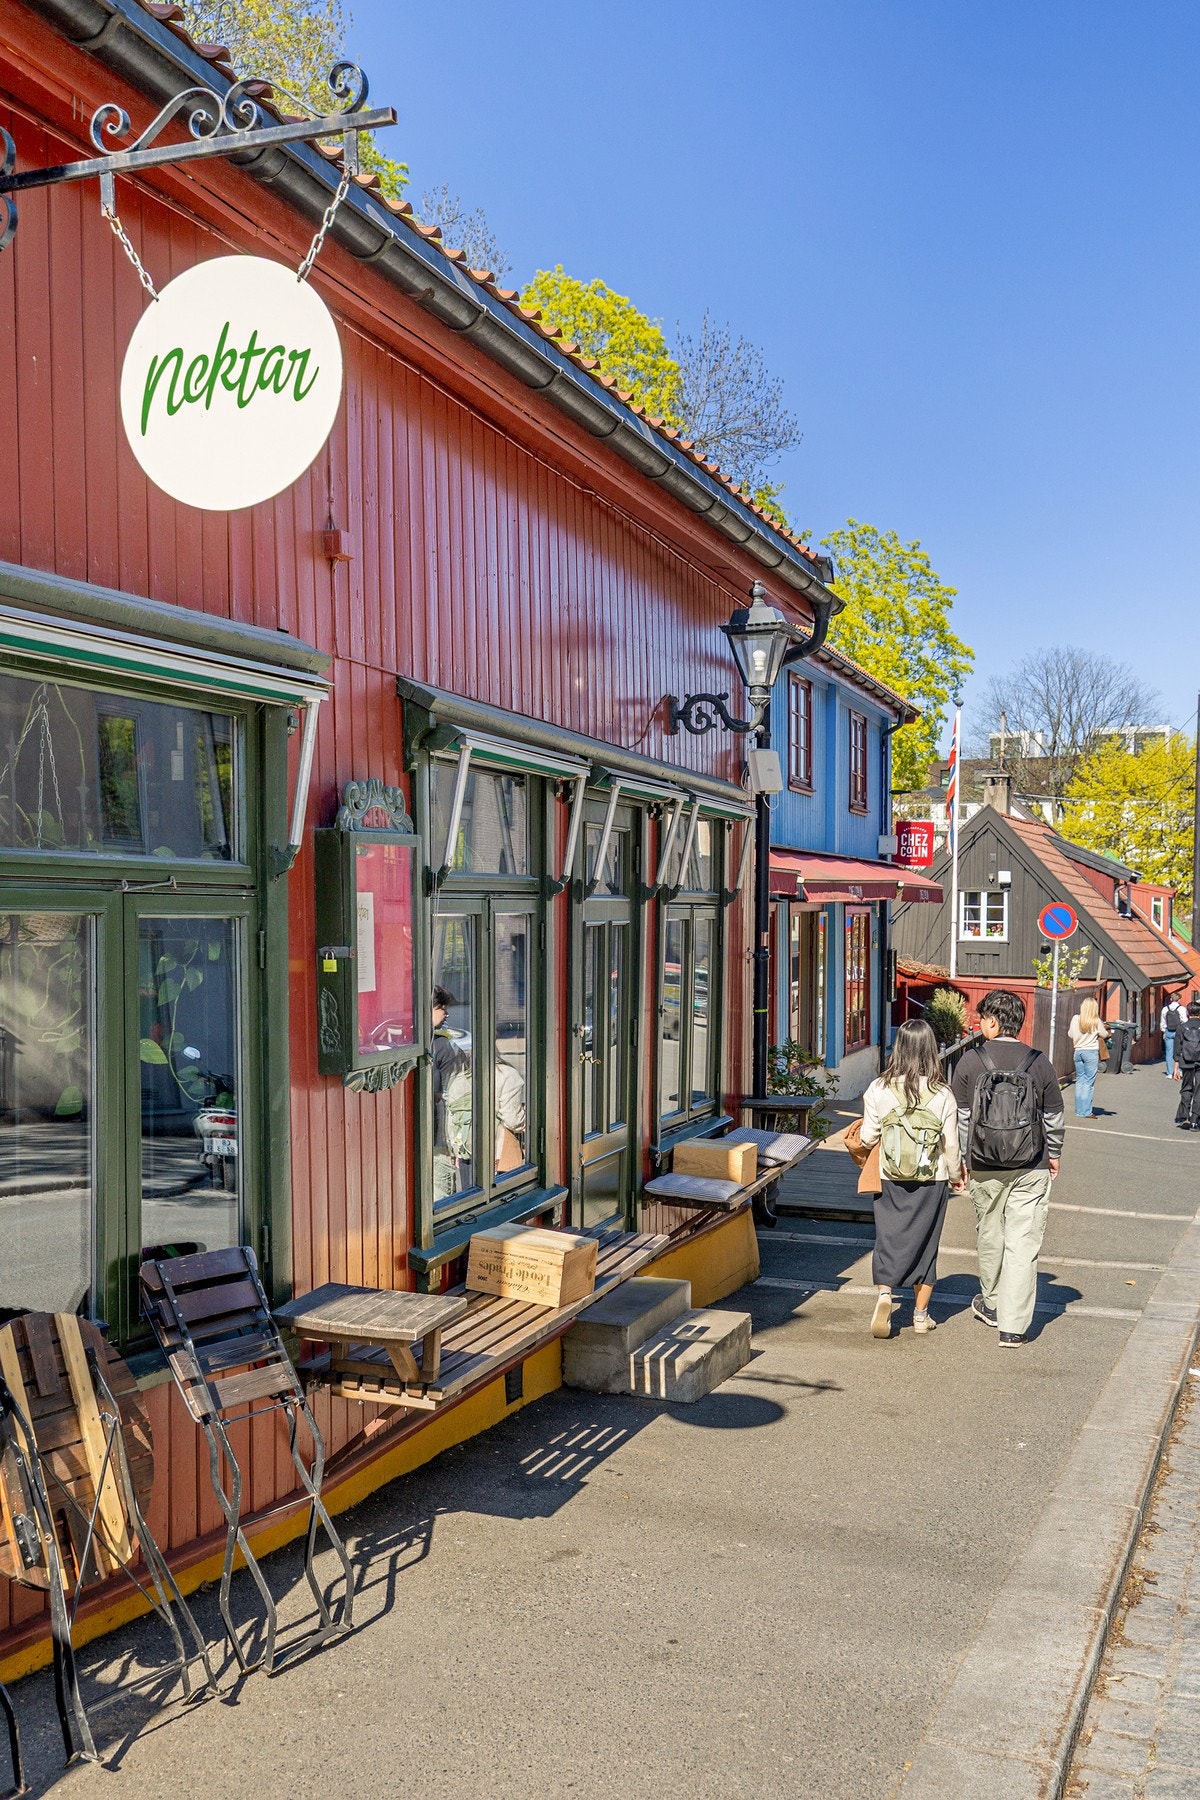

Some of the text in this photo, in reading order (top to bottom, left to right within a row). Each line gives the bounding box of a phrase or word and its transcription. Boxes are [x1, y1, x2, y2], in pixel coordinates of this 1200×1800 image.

[141, 321, 320, 436] nektar
[901, 833, 928, 846] CHEZ
[478, 1261, 514, 1279] Prades
[516, 1269, 529, 1282] de
